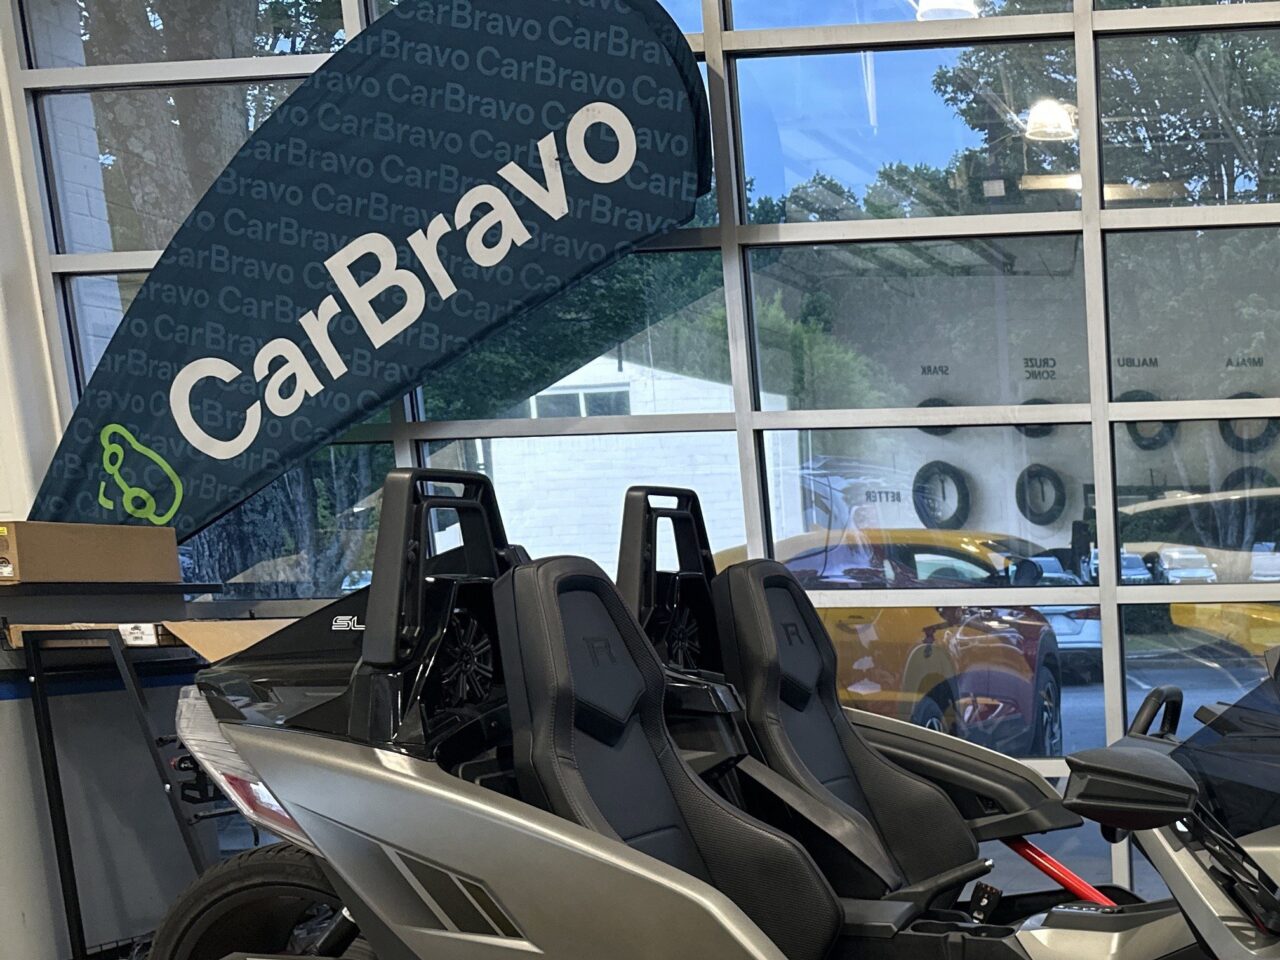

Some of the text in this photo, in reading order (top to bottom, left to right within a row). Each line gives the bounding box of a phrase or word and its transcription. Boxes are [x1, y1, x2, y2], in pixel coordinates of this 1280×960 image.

[476, 46, 626, 99] CarBravo
[386, 73, 535, 126] CarBravo
[318, 103, 463, 155] CarBravo
[169, 101, 637, 460] CarBravo
